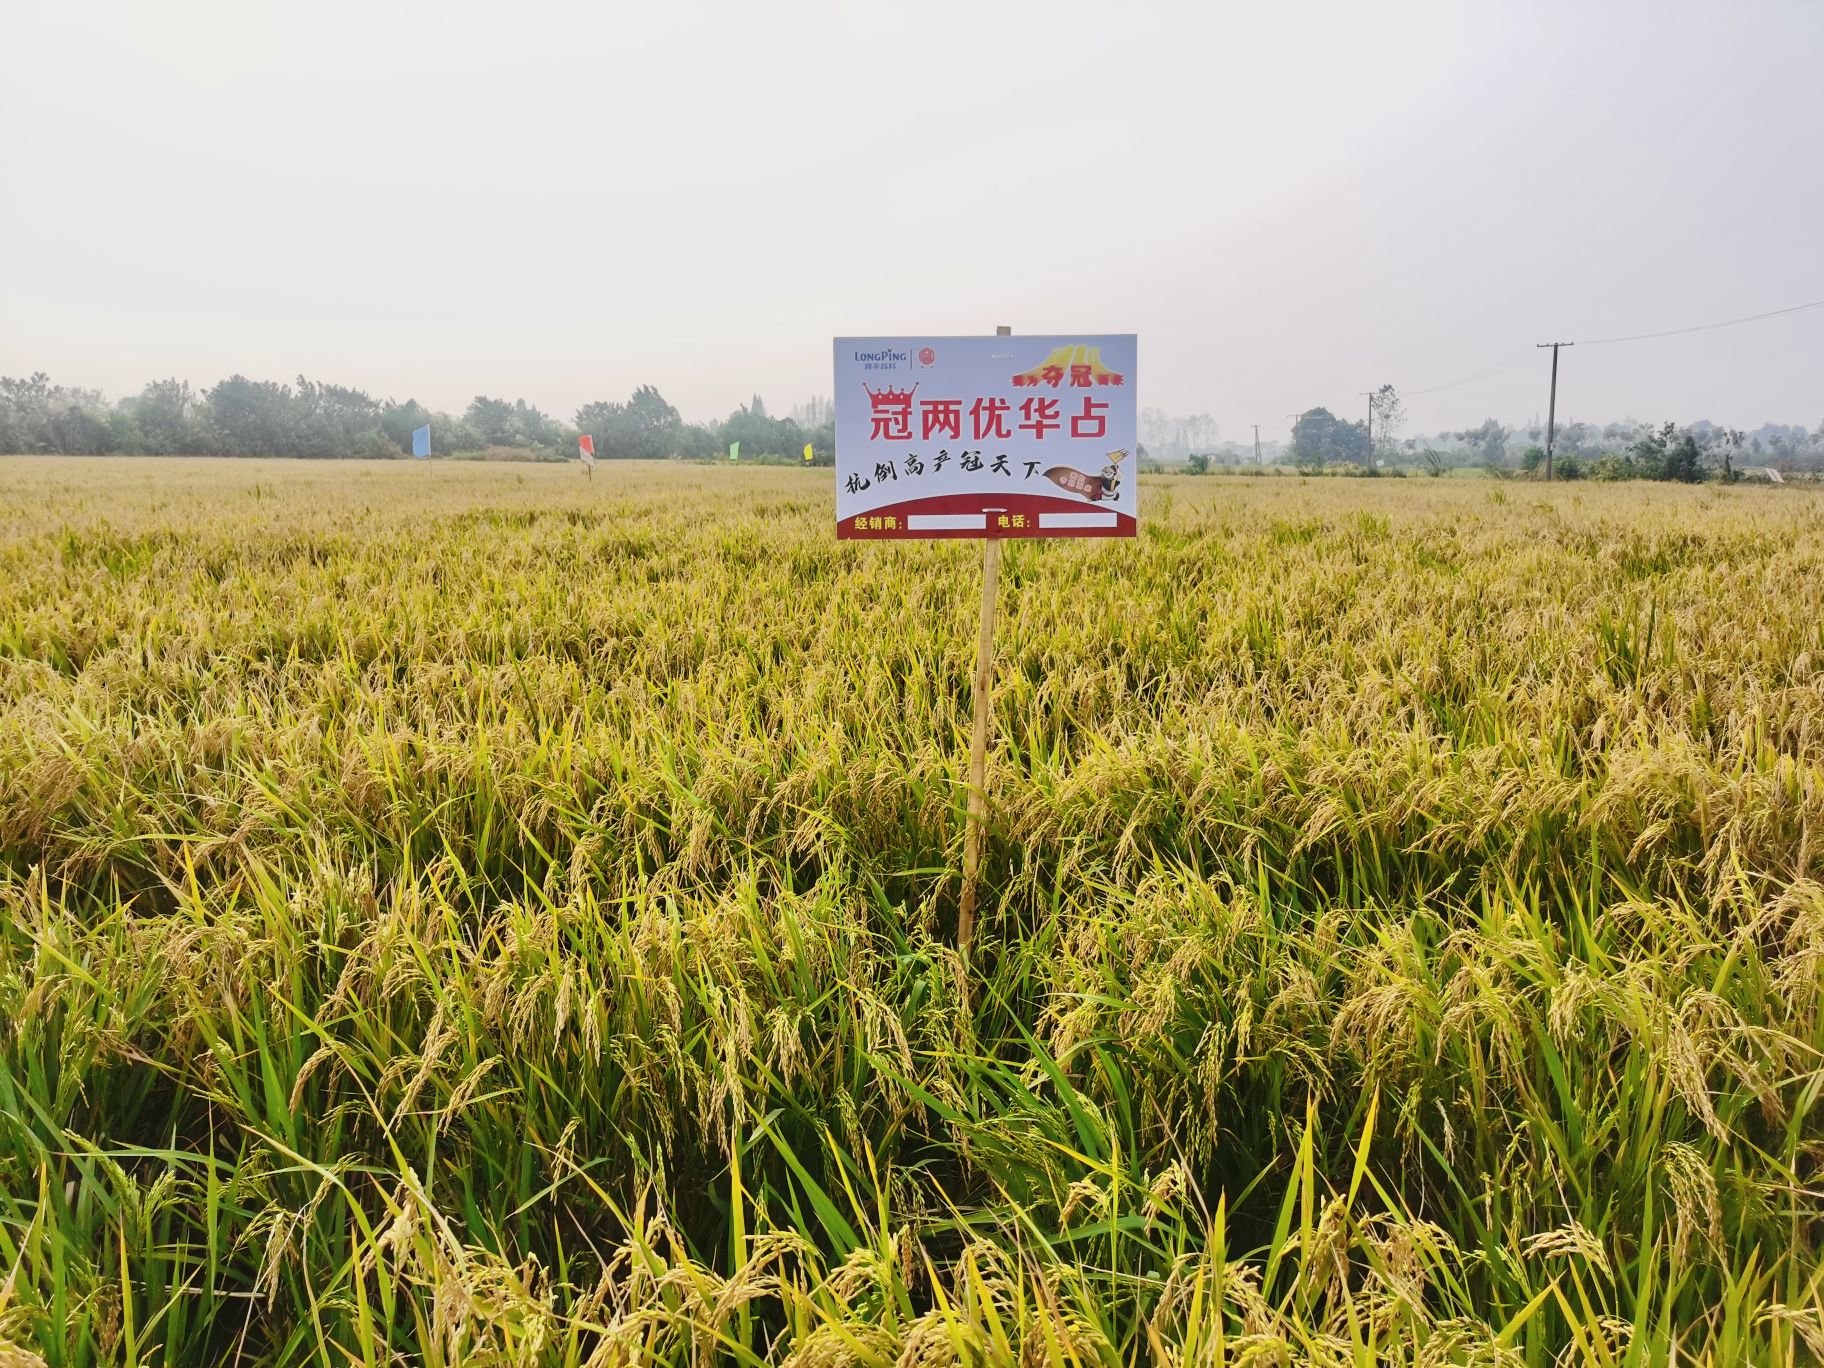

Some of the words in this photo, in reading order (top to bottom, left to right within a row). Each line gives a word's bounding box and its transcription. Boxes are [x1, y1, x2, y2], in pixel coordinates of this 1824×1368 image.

[870, 387, 1109, 441] 冠两优华占
[854, 516, 902, 530] 经销商：
[997, 514, 1030, 528] 电话：
